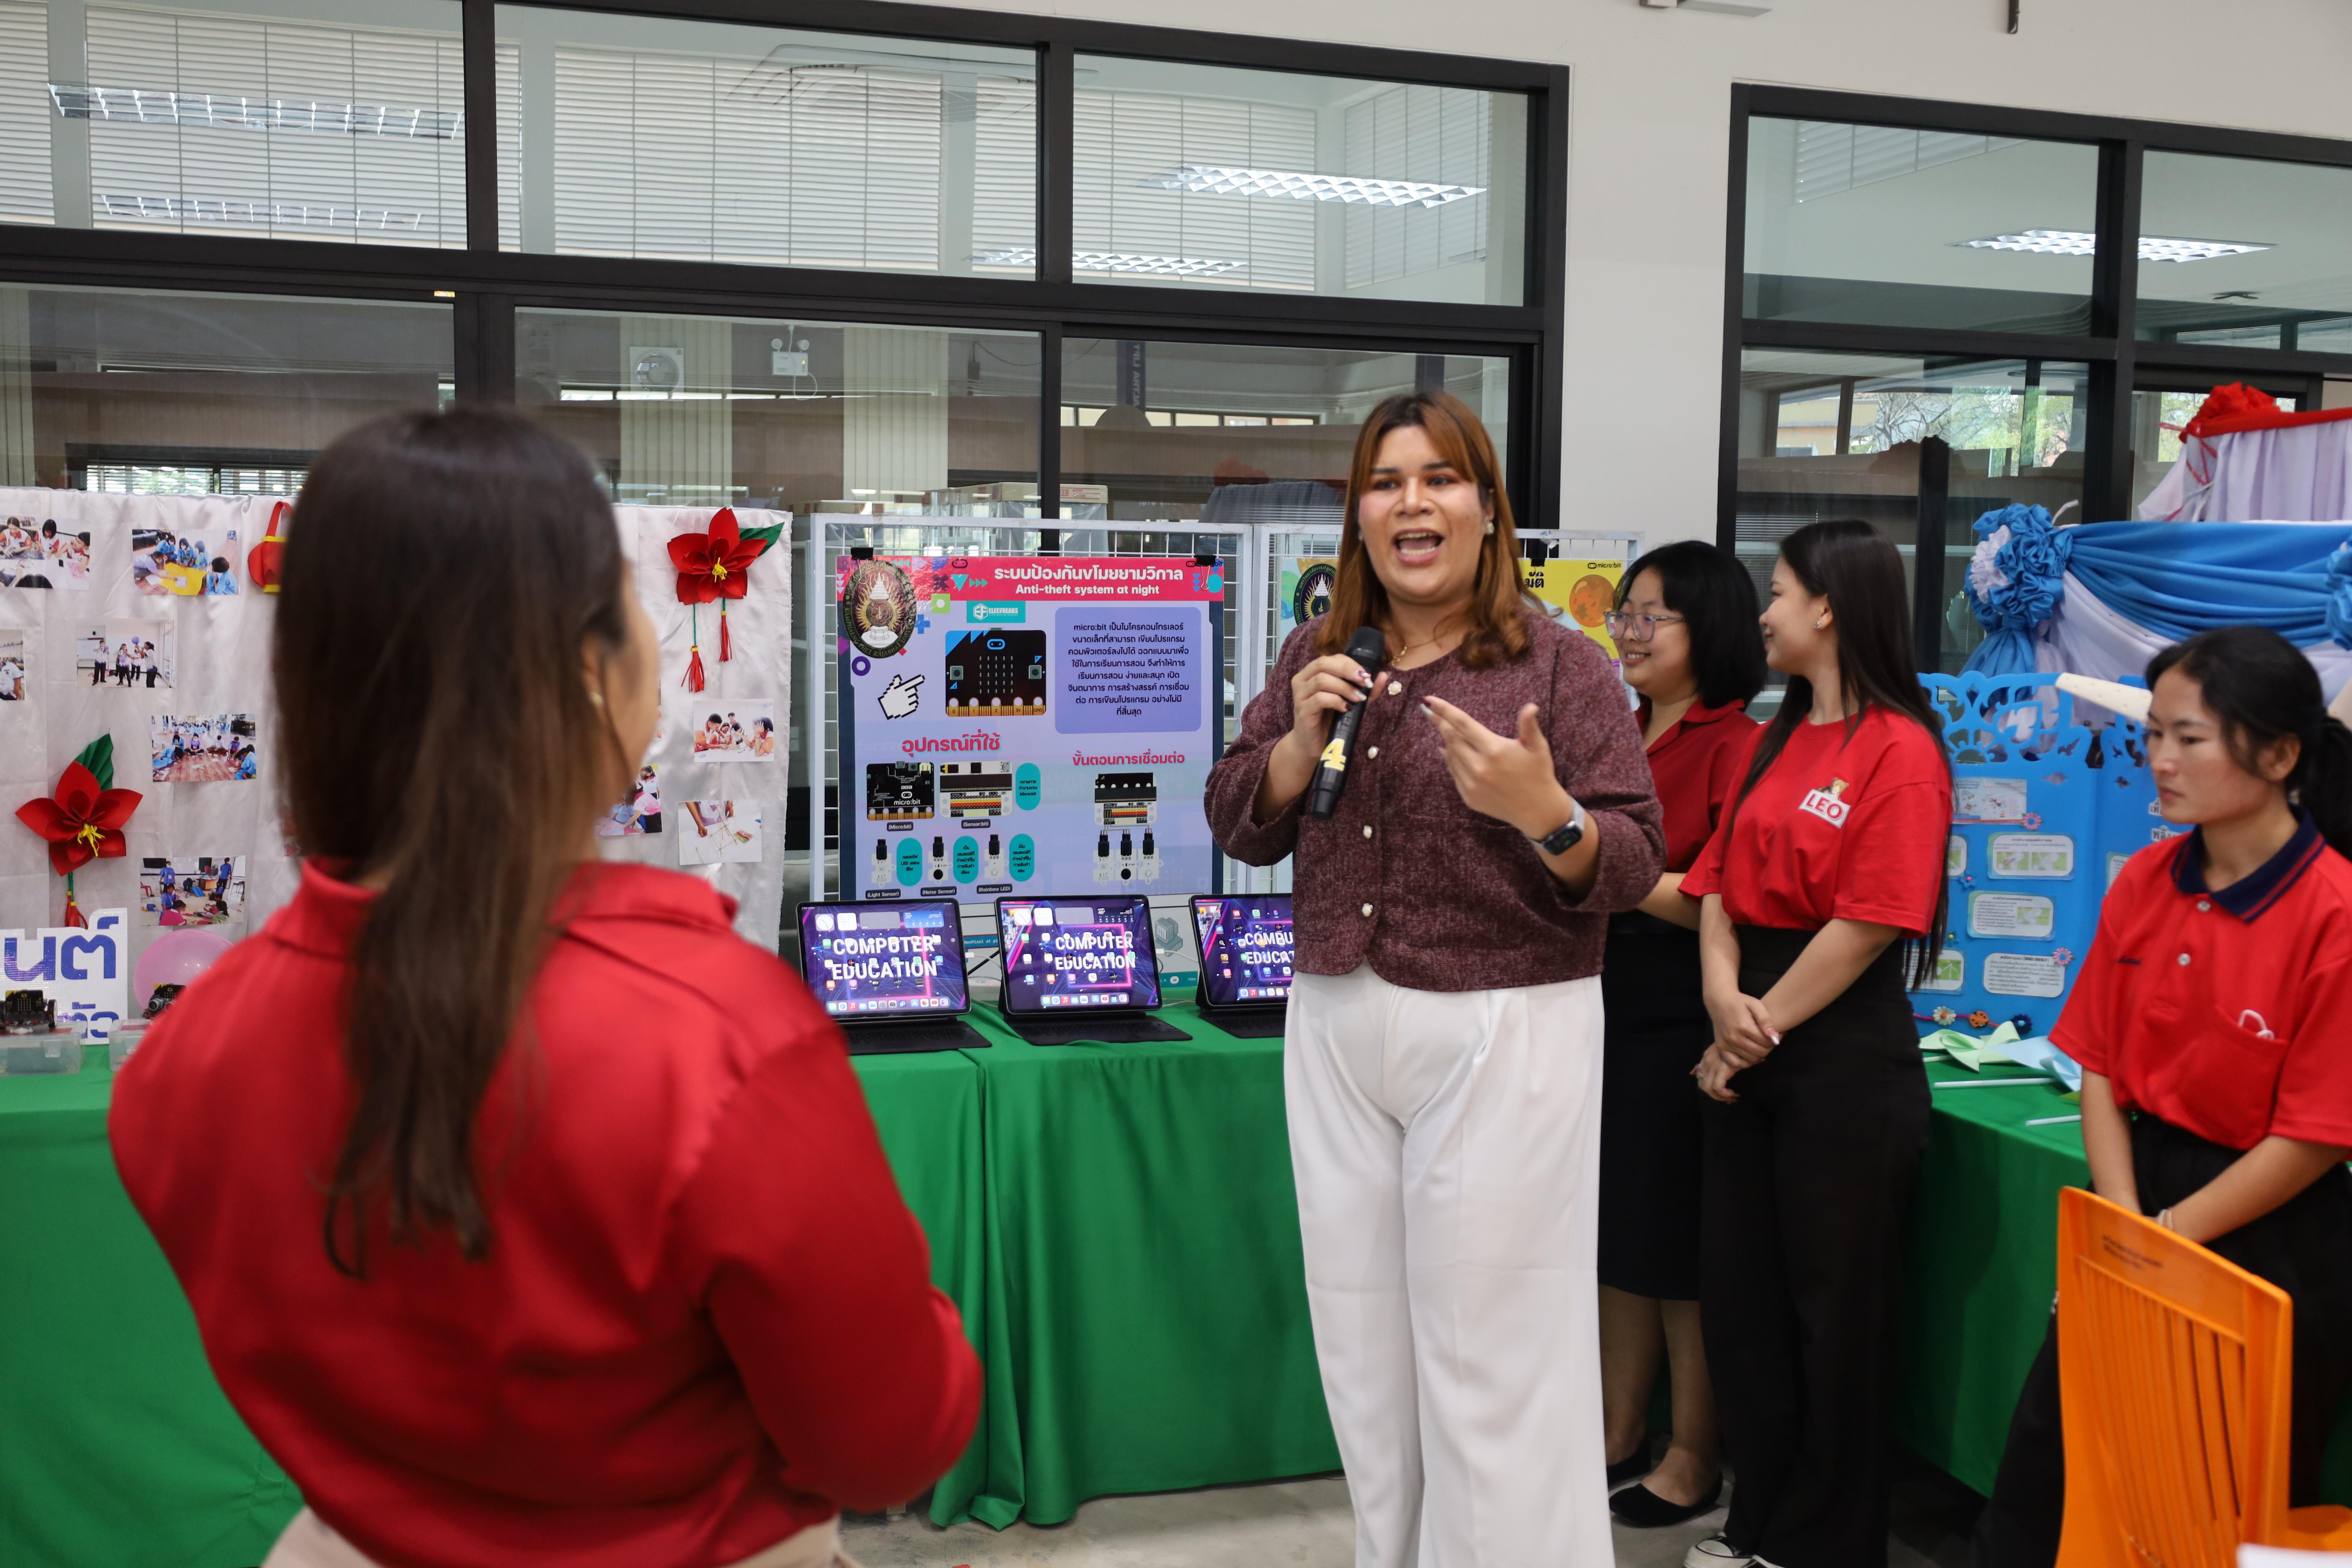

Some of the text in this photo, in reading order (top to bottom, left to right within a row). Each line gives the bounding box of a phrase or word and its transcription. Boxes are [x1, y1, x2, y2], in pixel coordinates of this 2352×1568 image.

[994, 564, 1183, 580] ระบบป้องกันขโมยยามวิกาล
[1015, 584, 1160, 596] Anti-theft system at night
[1109, 622, 1184, 631] เป็นไมโครคอนโทรเลอร์
[1072, 634, 1185, 643] ขนาดเล็กที่สามารถ เขียนโปรแกรม
[1068, 645, 1189, 655] คอมพิวเตอร์ลงไปได้ ออกแบบมาเพื่อ
[1072, 658, 1185, 668] ใช้ในการเรียนการสอน จึงทำให้การ
[1126, 671, 1165, 680] ง่ายและสนุก
[1167, 671, 1180, 679] เปิด
[1108, 683, 1157, 691] การสร้างสรรค์
[1159, 680, 1189, 691] การเชื่อม
[1152, 694, 1182, 703] อย่างไม่มี
[1116, 706, 1142, 717] ที่สิ้นสุด
[902, 729, 1001, 757] อุปกรณ์ที่ใช้
[1072, 748, 1185, 766] ขั้นตอนการเชื่อมต่อ
[1320, 738, 1346, 771] 4
[1806, 793, 1844, 819] LEO
[833, 936, 935, 955] COMPUTER
[1056, 936, 1133, 950] COMPUTER
[1244, 931, 1294, 946] COMPU
[5, 916, 119, 981] นต์
[832, 960, 937, 980] EDUCATION
[1056, 956, 1136, 970] EDUCATION
